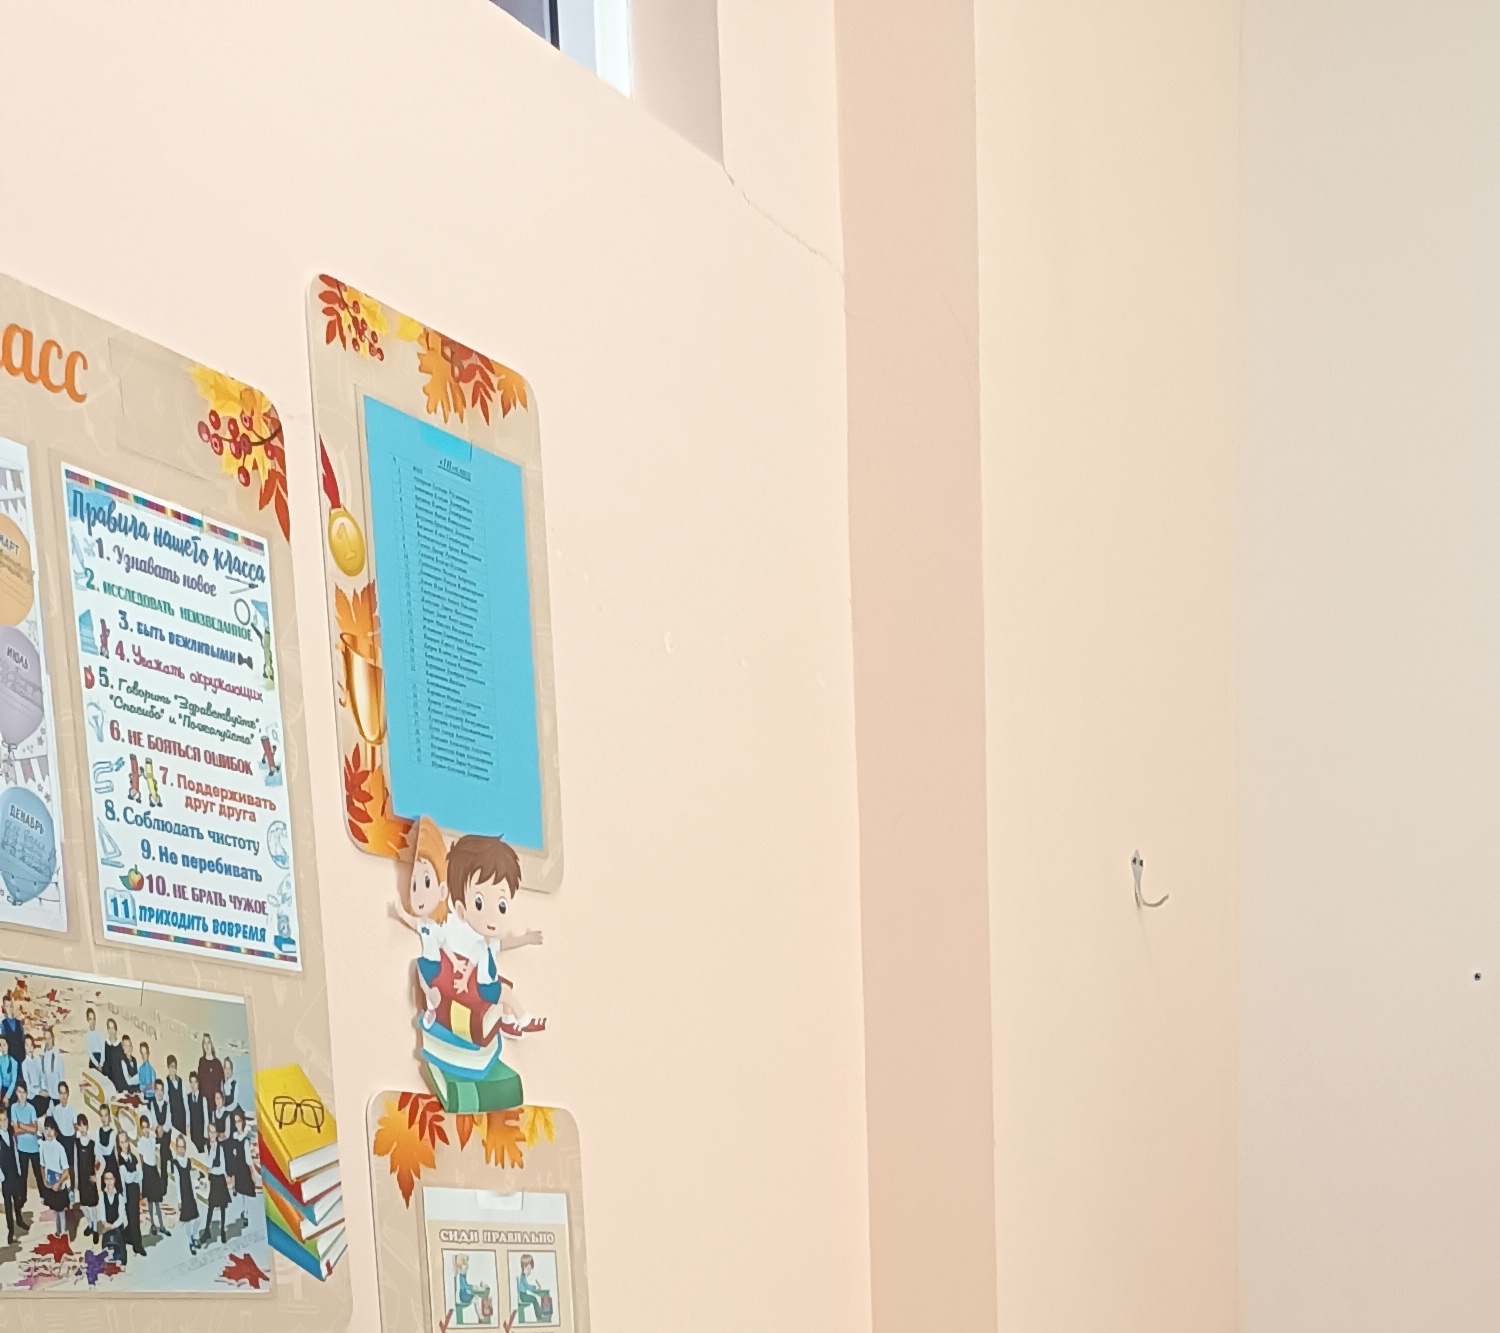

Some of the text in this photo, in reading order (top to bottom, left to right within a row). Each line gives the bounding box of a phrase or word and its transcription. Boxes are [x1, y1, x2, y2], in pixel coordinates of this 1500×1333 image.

[0, 322, 88, 403] асс
[72, 489, 266, 583] Правила нашего класса
[95, 537, 217, 597] 1. Узнавать новое
[84, 567, 253, 642] 2. ИССЛЕДОВАТЬ НЕИЗВЕДАННОЕ
[6, 645, 29, 670] ИЮЛЬ
[118, 609, 236, 665] 3. БЫТЬ ВЕЖЛИВЫМИ
[98, 666, 114, 689] 5.
[118, 678, 171, 706] Говорить
[114, 640, 264, 704] 4. Уважать окружающих
[168, 715, 177, 725] и
[109, 719, 254, 776] 6. НЕ БОЯТЬСЯ ОШИБОК
[159, 766, 277, 812] 7. Поддерживать
[184, 795, 257, 823] друг друга
[9, 804, 44, 835] ДЕКАБРЬ
[104, 799, 260, 856] 8. Соблюдать чистоту
[140, 839, 156, 861] 9.
[181, 852, 263, 883] перебивать
[146, 874, 268, 916] 10. НЕ БРАТЬ ЧУЖОЕ
[110, 897, 267, 943] 11. ПРИХОДИТЬ ВОВРЕМЯ
[439, 1229, 556, 1245] СИДИ ПРАВИЛЬНО
